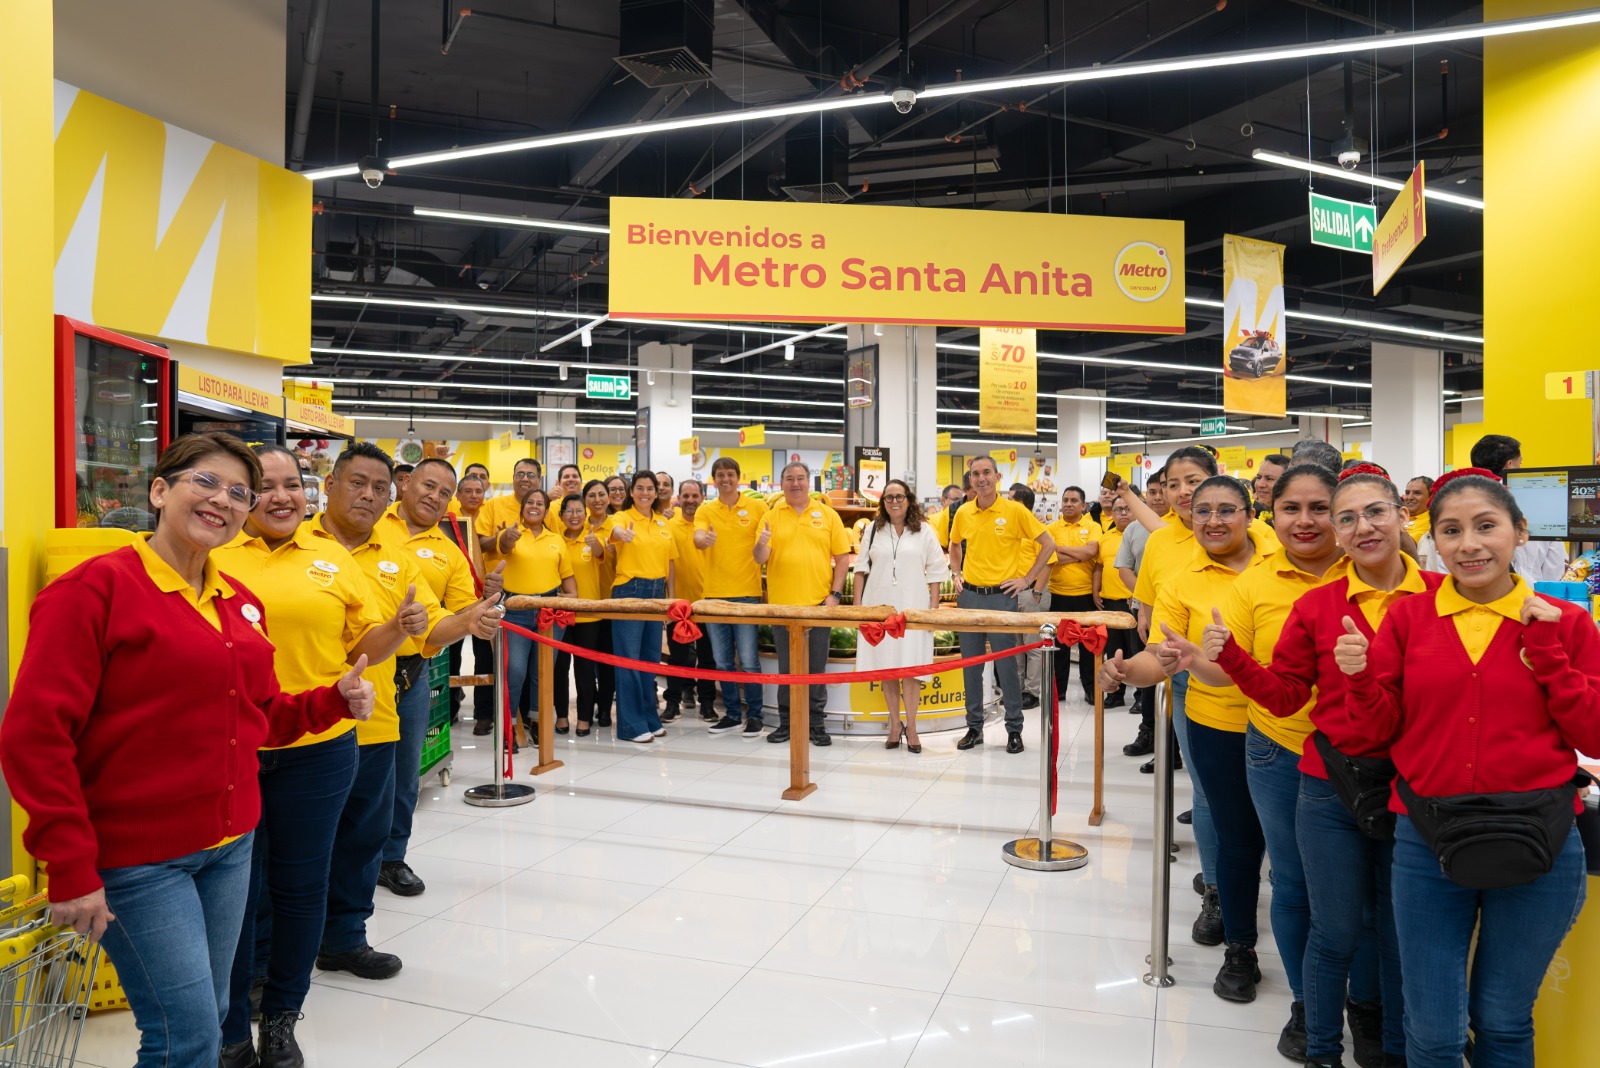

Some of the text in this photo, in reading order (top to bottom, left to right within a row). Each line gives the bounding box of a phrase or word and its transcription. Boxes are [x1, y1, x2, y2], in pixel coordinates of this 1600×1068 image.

[1313, 207, 1352, 238] SALIDA
[627, 223, 826, 249] Bienvenidos a
[1381, 208, 1409, 260] Preferencial
[693, 254, 1093, 297] Metro Santa Anita
[1119, 263, 1167, 278] Metro
[198, 376, 269, 410] LISTO PARA LLEVAR
[588, 380, 614, 393] SALIDA
[1562, 376, 1573, 394] 1
[300, 407, 314, 423] LISTO
[315, 411, 327, 425] PARA
[583, 464, 614, 473] Pollos
[867, 474, 874, 489] 2
[1571, 486, 1596, 495] 40%
[309, 570, 332, 579] Metro
[380, 573, 397, 582] Metro
